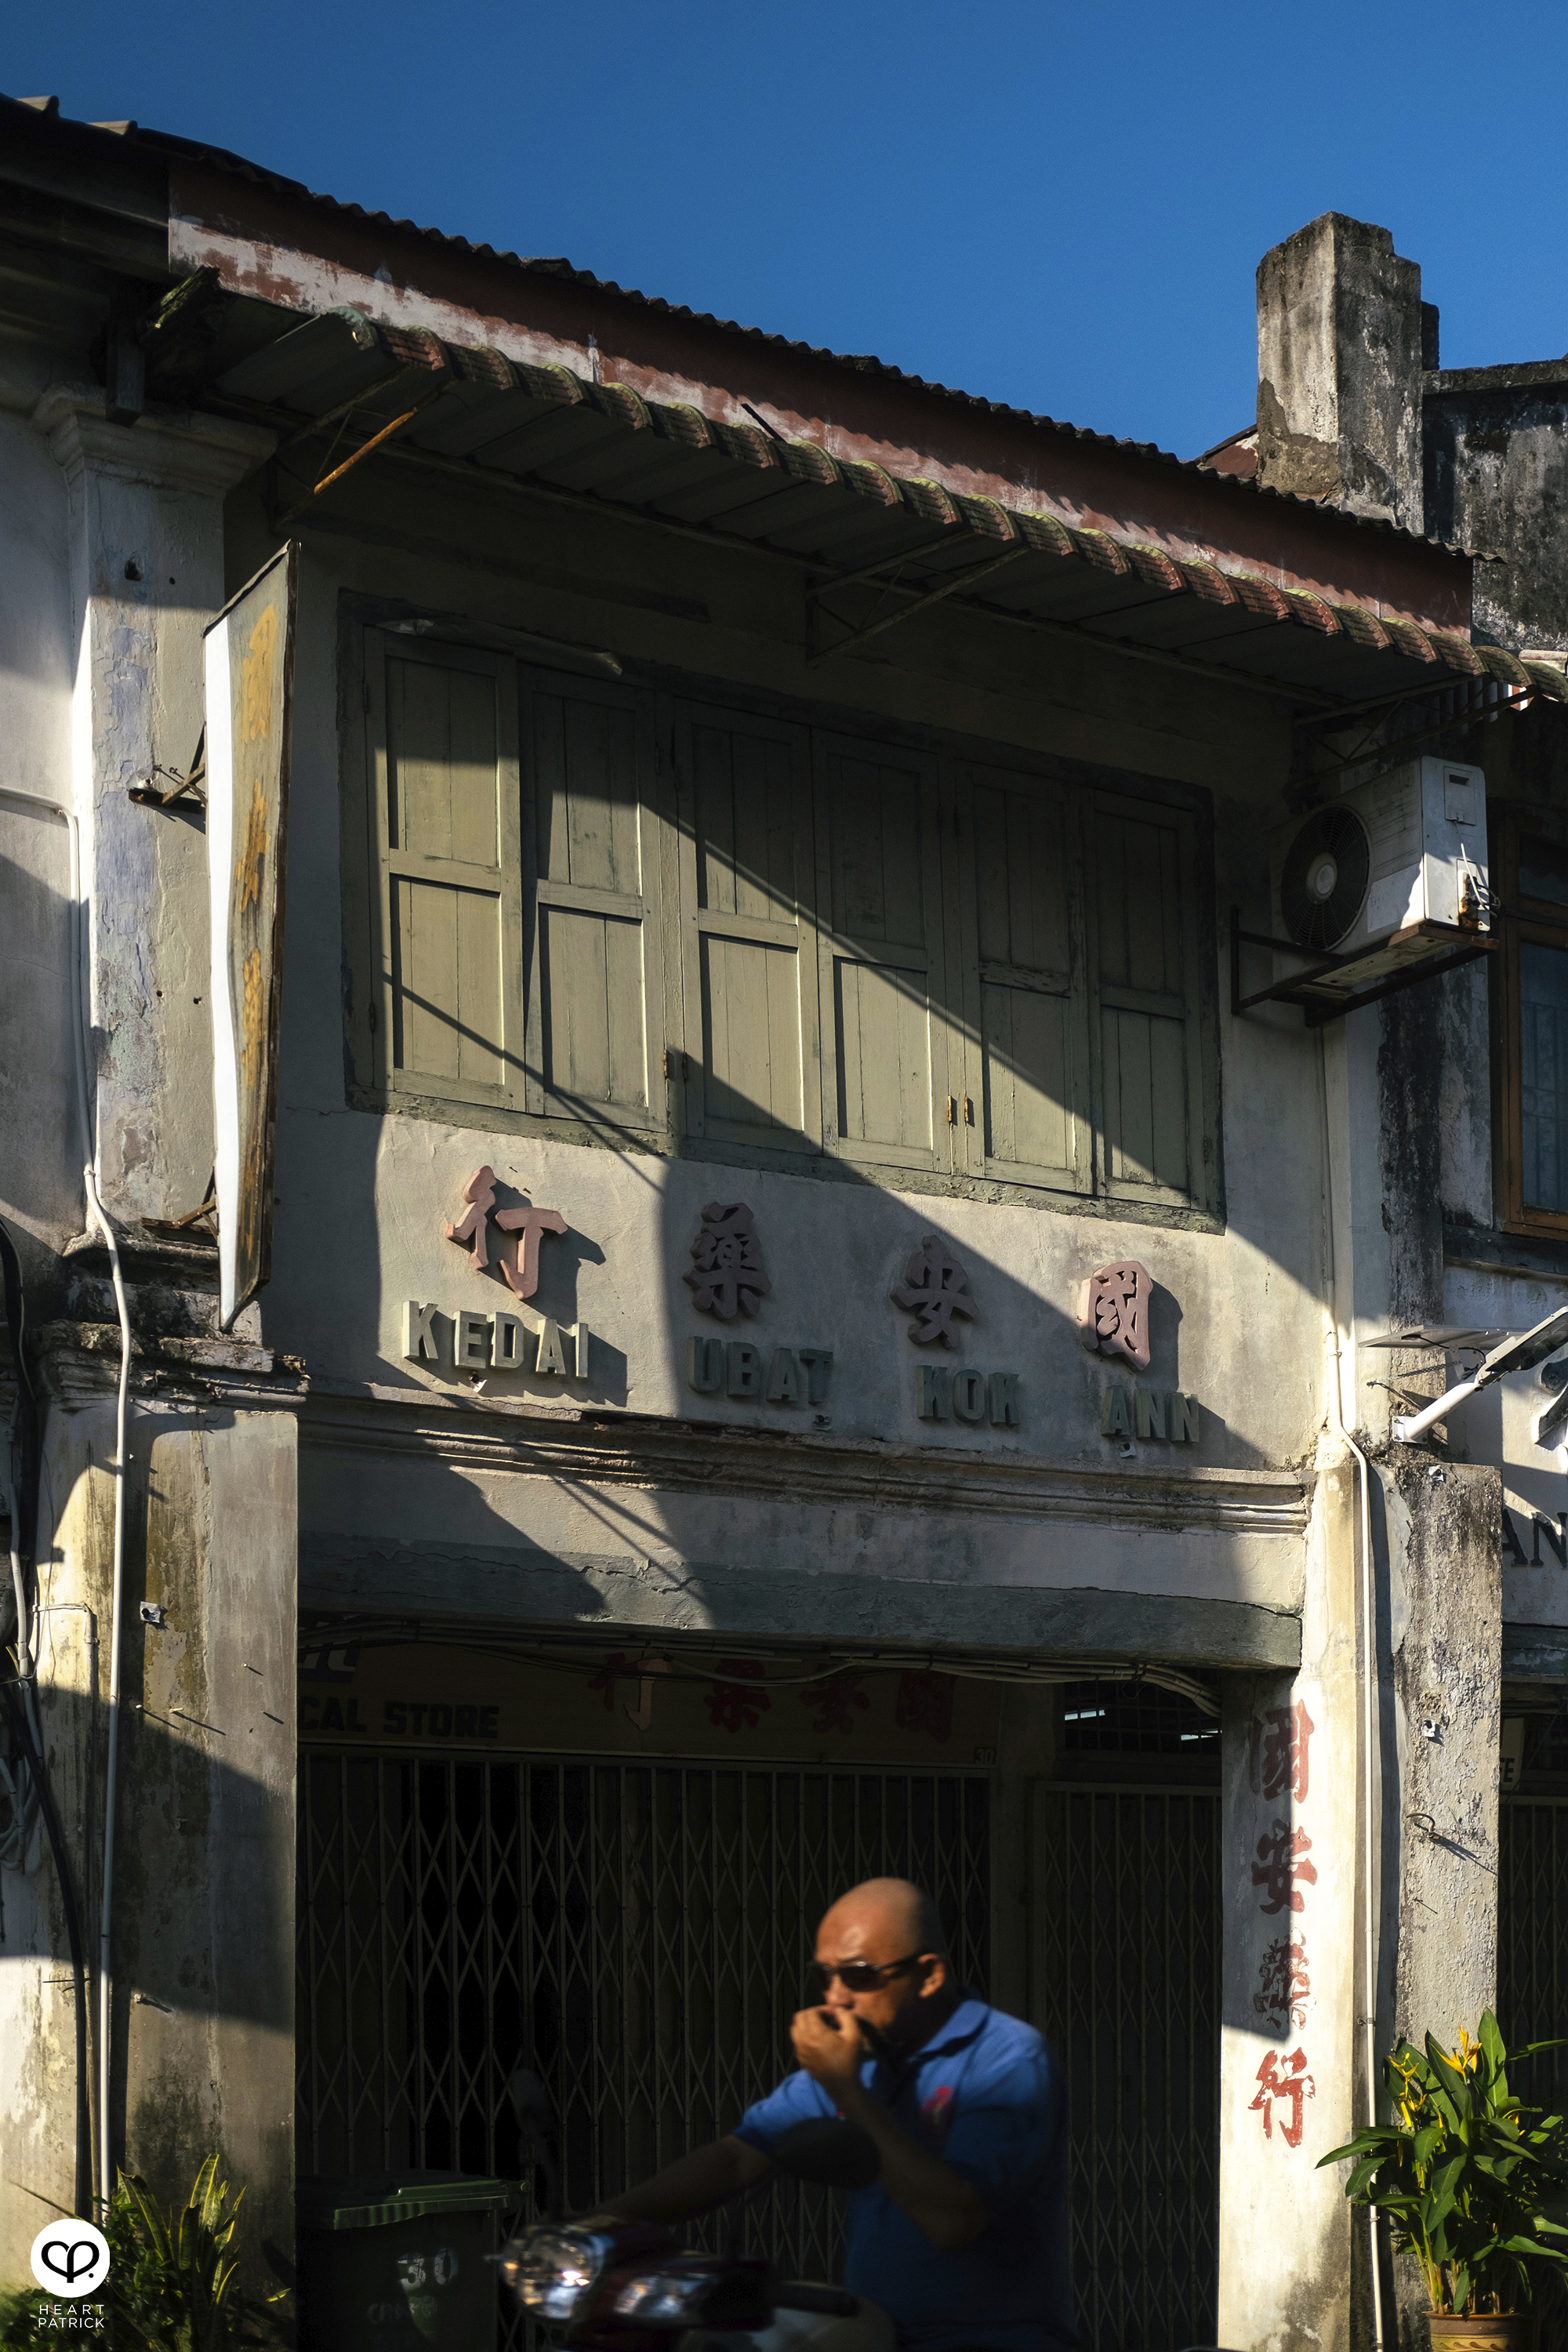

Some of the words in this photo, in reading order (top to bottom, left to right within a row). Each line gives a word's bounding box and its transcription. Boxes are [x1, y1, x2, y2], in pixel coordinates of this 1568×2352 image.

[402, 1300, 589, 1379] KEDAI
[688, 1335, 833, 1406] UBAT
[915, 1364, 1020, 1427] KOK
[1100, 1385, 1200, 1444] ANN
[383, 1700, 500, 1739] STORE
[975, 1748, 995, 1765] 30
